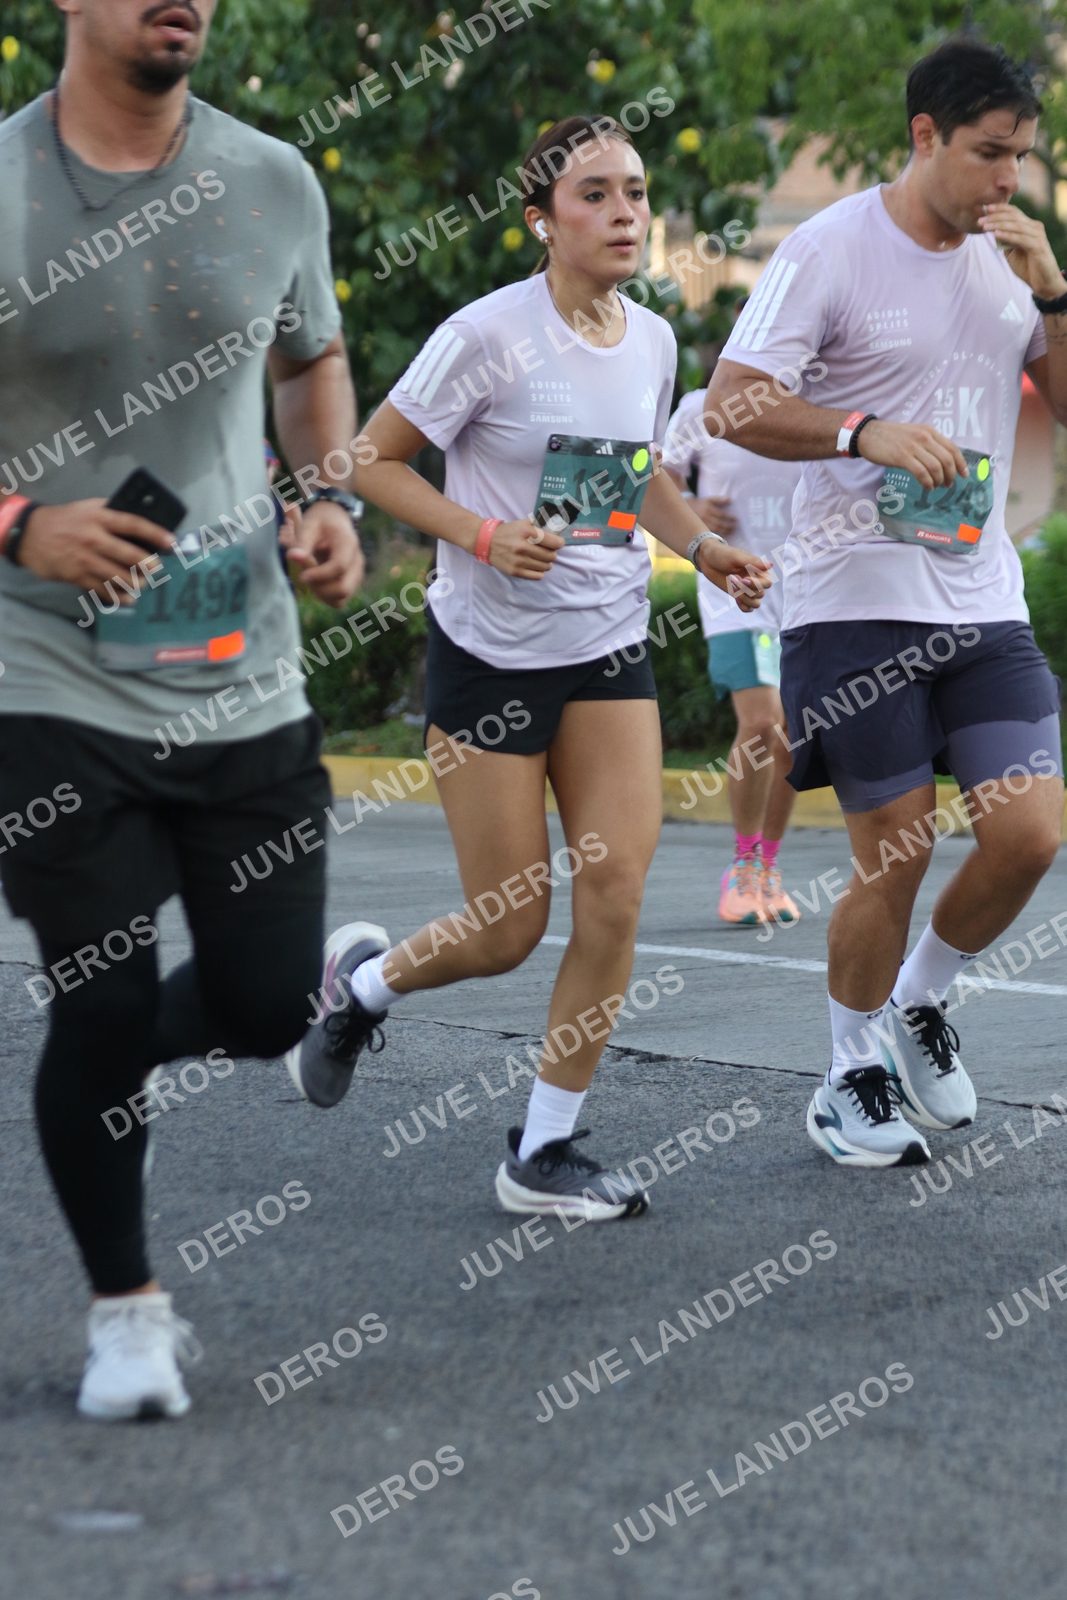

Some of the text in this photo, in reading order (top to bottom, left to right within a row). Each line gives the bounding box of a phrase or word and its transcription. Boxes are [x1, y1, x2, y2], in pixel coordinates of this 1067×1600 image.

[866, 307, 909, 321] ADIDAS
[529, 381, 571, 391] ADIDAS
[531, 393, 572, 402] SPLITS
[933, 387, 954, 408] 15
[957, 387, 985, 437] K
[530, 414, 573, 424] SAMSUNG
